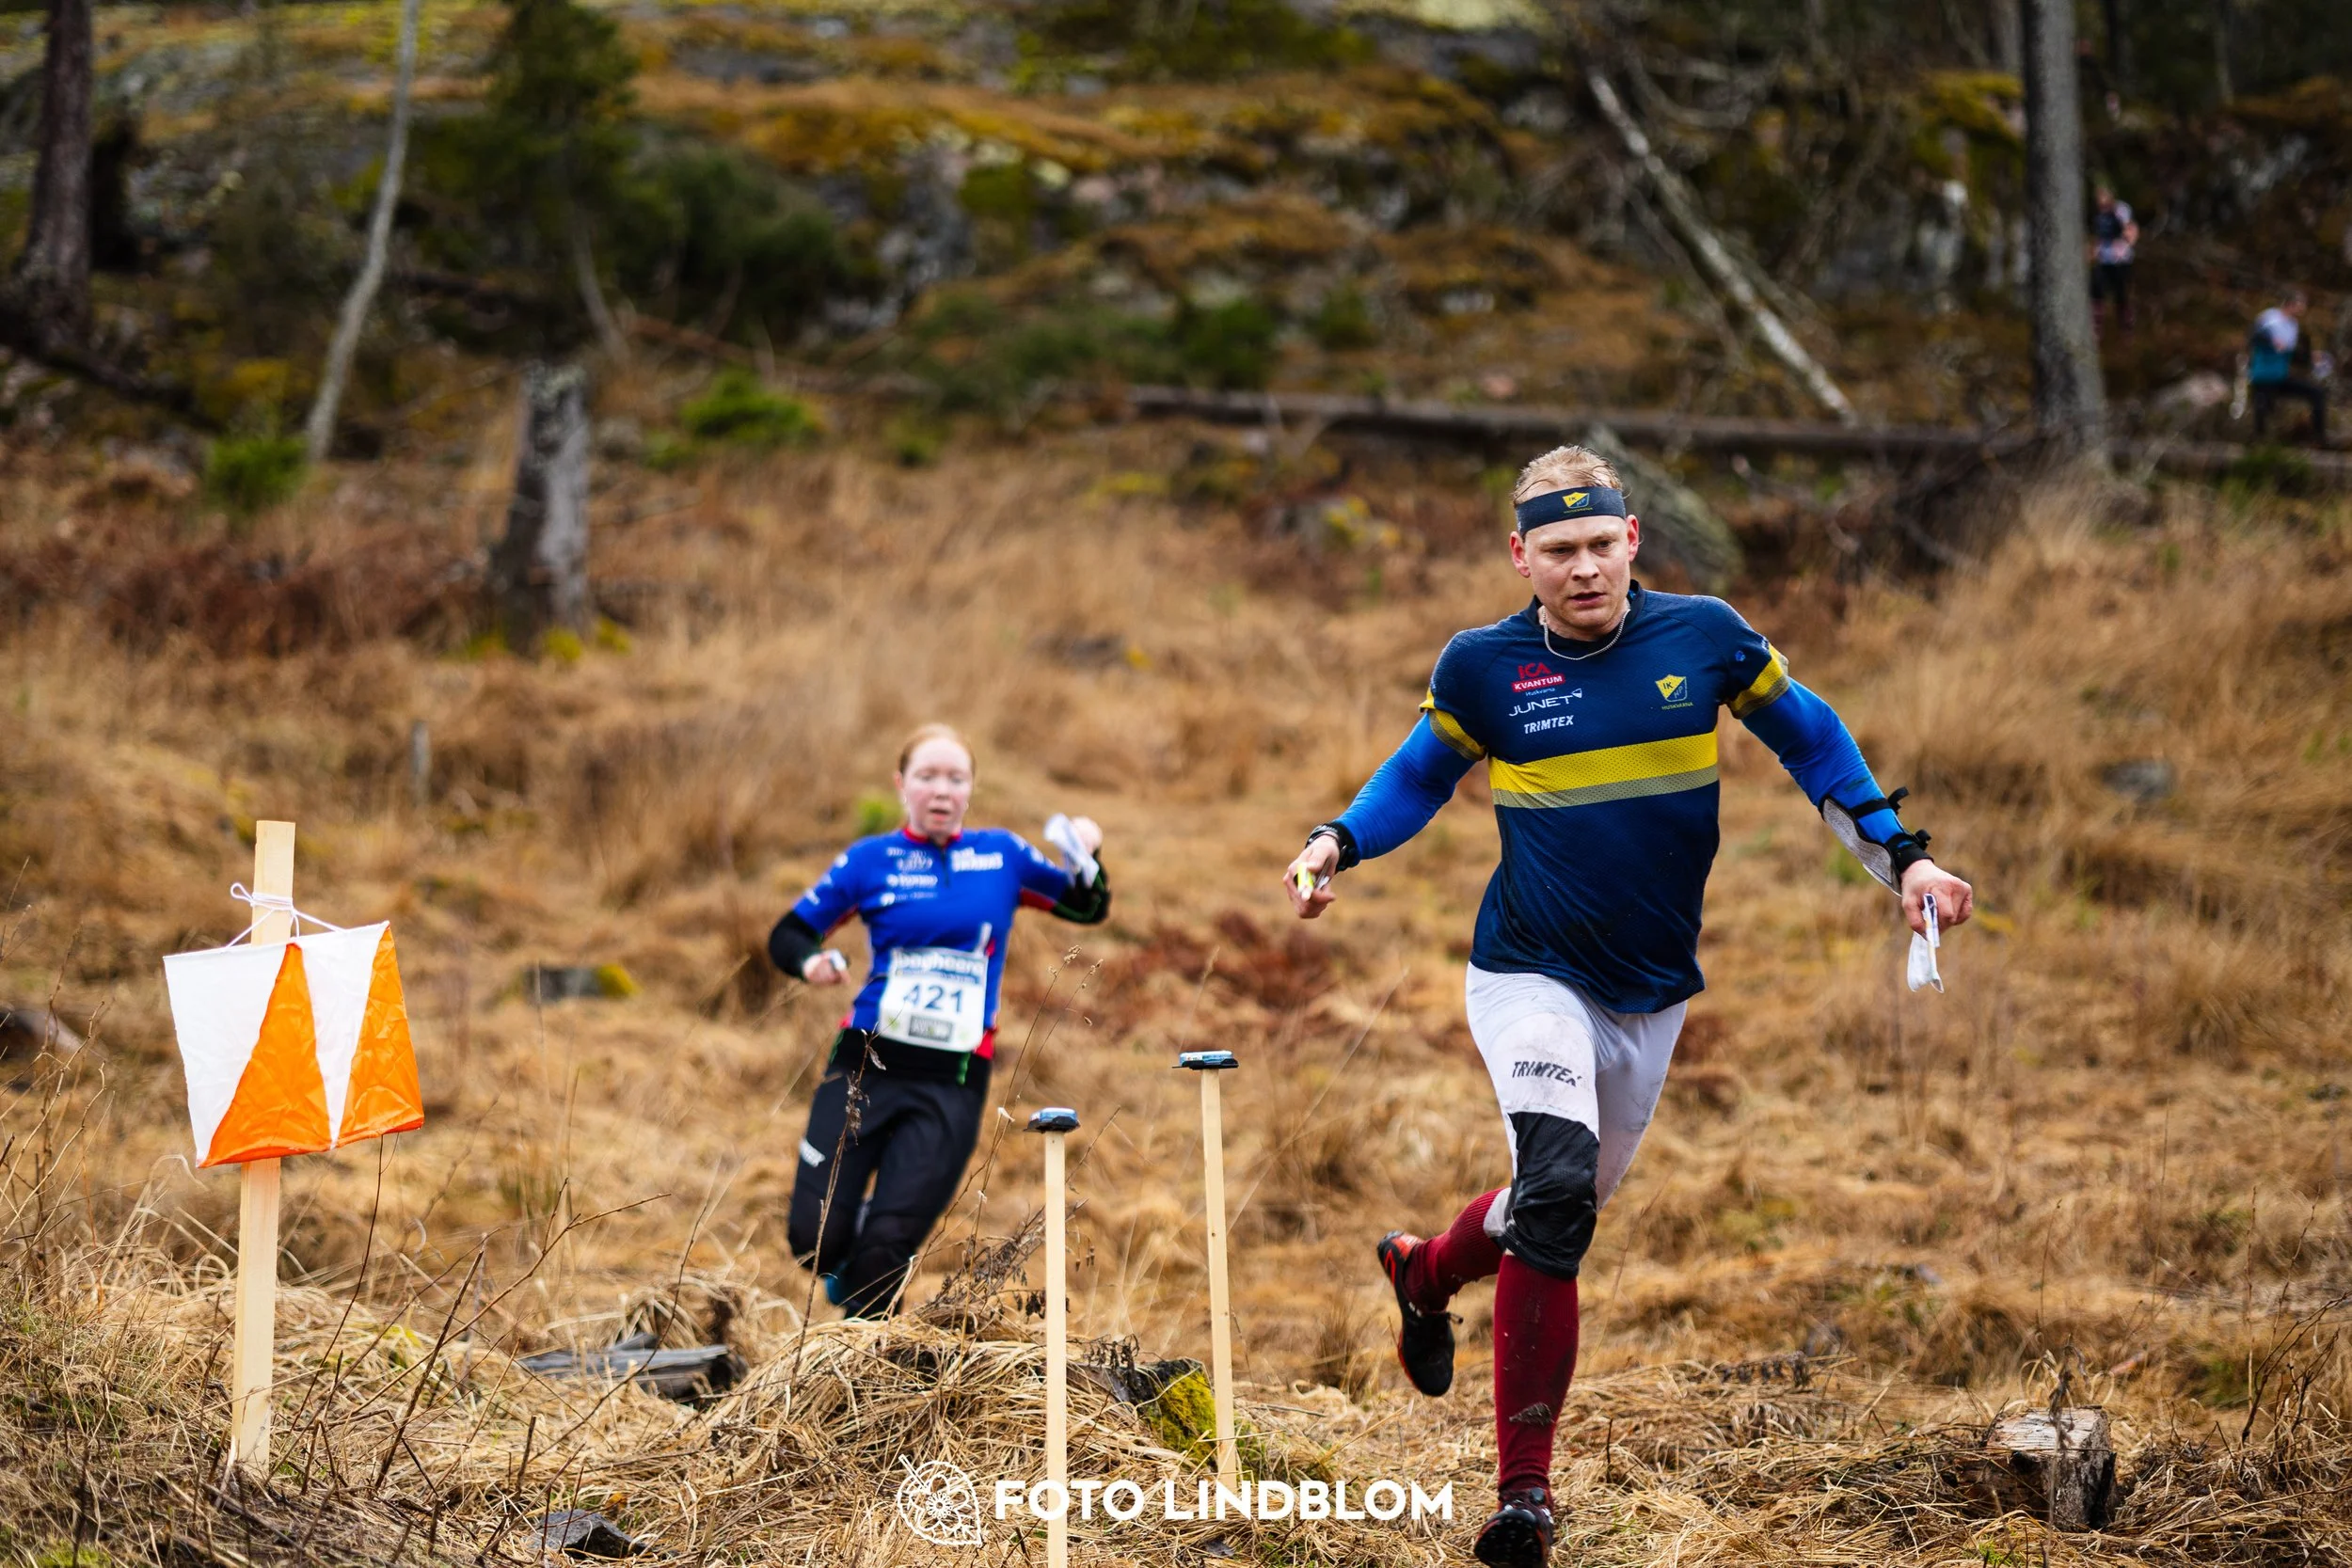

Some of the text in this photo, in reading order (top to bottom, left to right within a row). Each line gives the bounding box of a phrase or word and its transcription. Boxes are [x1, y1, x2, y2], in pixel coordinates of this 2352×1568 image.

[1518, 663, 1550, 678] ICA
[1514, 675, 1563, 690] KVANTUM
[1662, 681, 1674, 689] IK
[1508, 695, 1574, 717] JUNET
[1524, 715, 1574, 734] TRIMTEX
[903, 983, 963, 1013] 421
